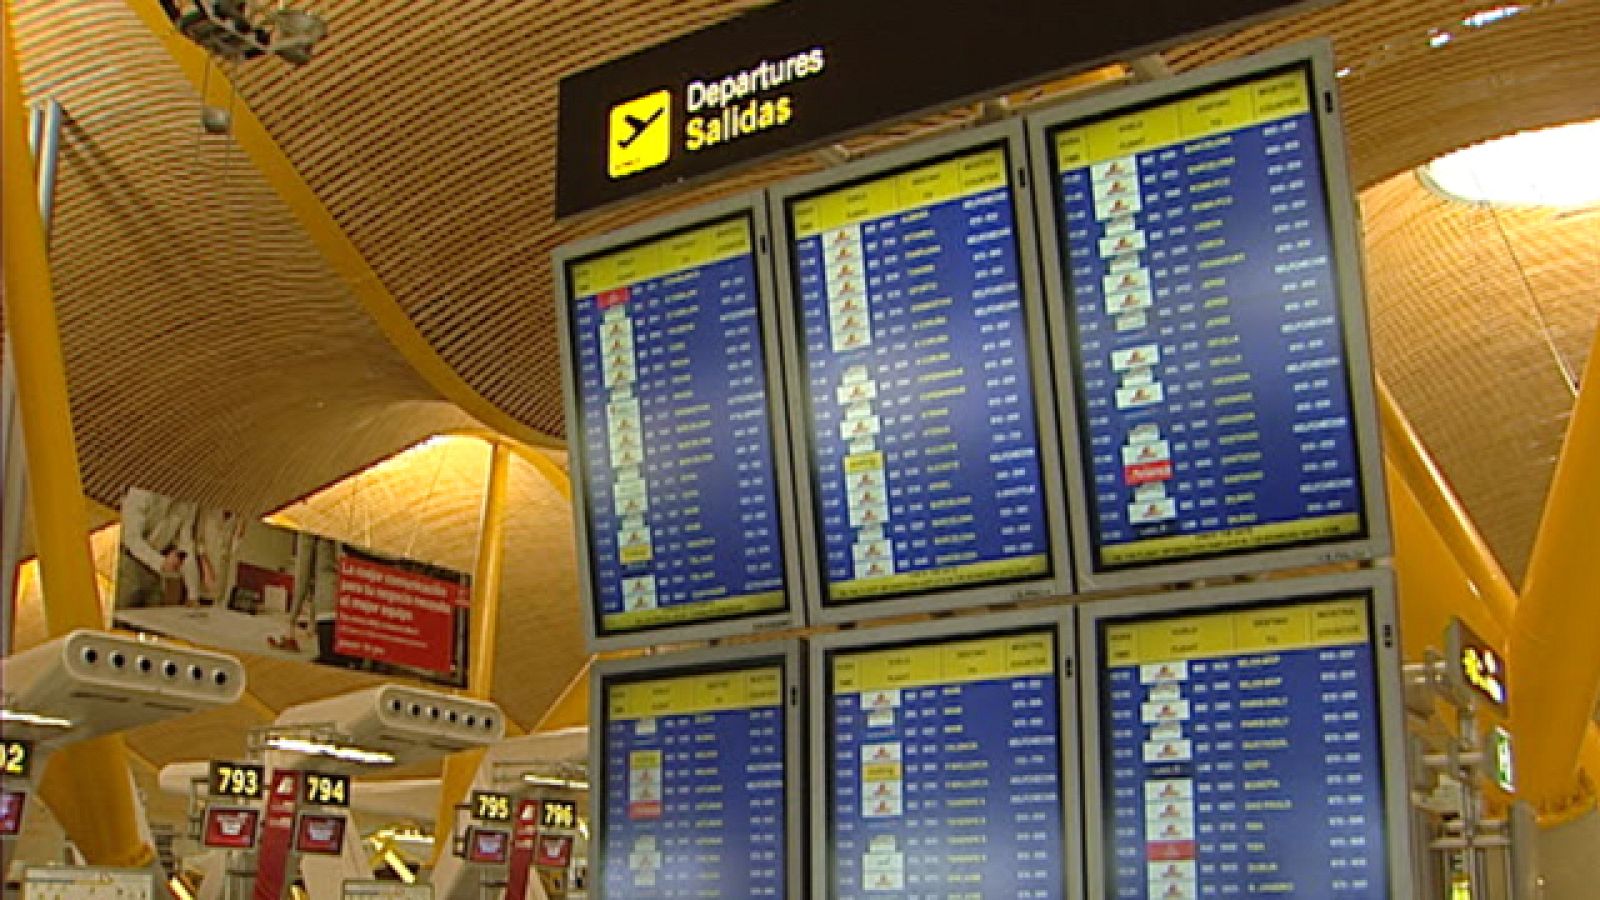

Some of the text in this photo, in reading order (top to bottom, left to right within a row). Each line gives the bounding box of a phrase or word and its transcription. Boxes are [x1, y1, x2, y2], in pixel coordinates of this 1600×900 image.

[687, 47, 825, 112] Departures
[685, 96, 792, 150] Salidas
[218, 767, 257, 796] 793
[307, 775, 343, 803] 794
